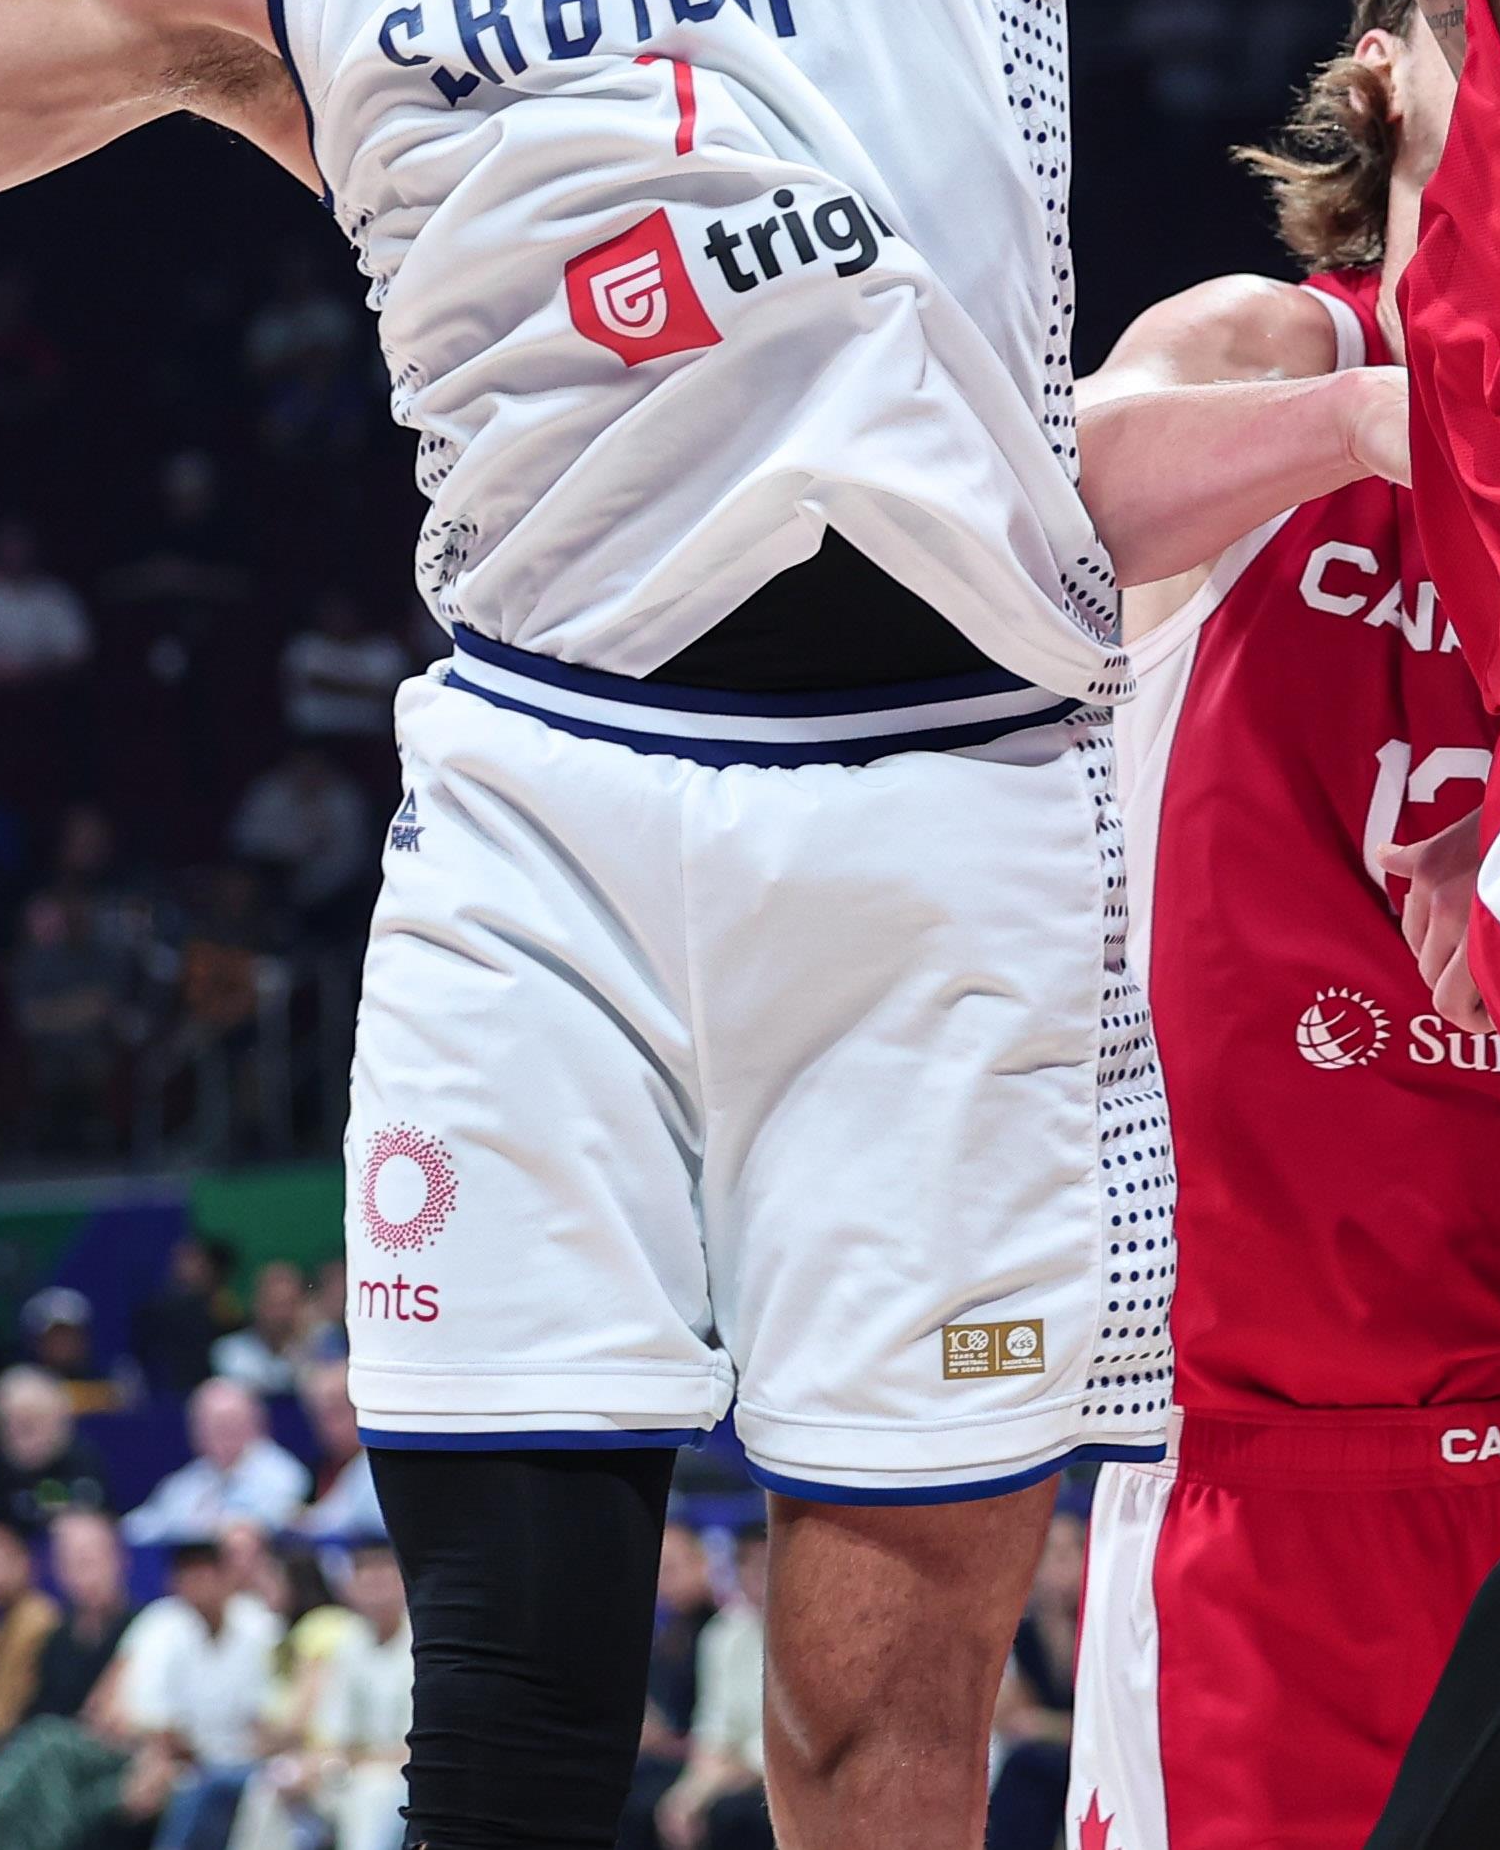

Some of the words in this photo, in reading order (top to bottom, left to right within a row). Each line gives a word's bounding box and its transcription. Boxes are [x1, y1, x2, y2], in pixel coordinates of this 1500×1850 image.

[633, 54, 695, 156] 7
[703, 188, 896, 293] trig
[1300, 540, 1462, 653] CAN
[358, 1274, 439, 1323] mts
